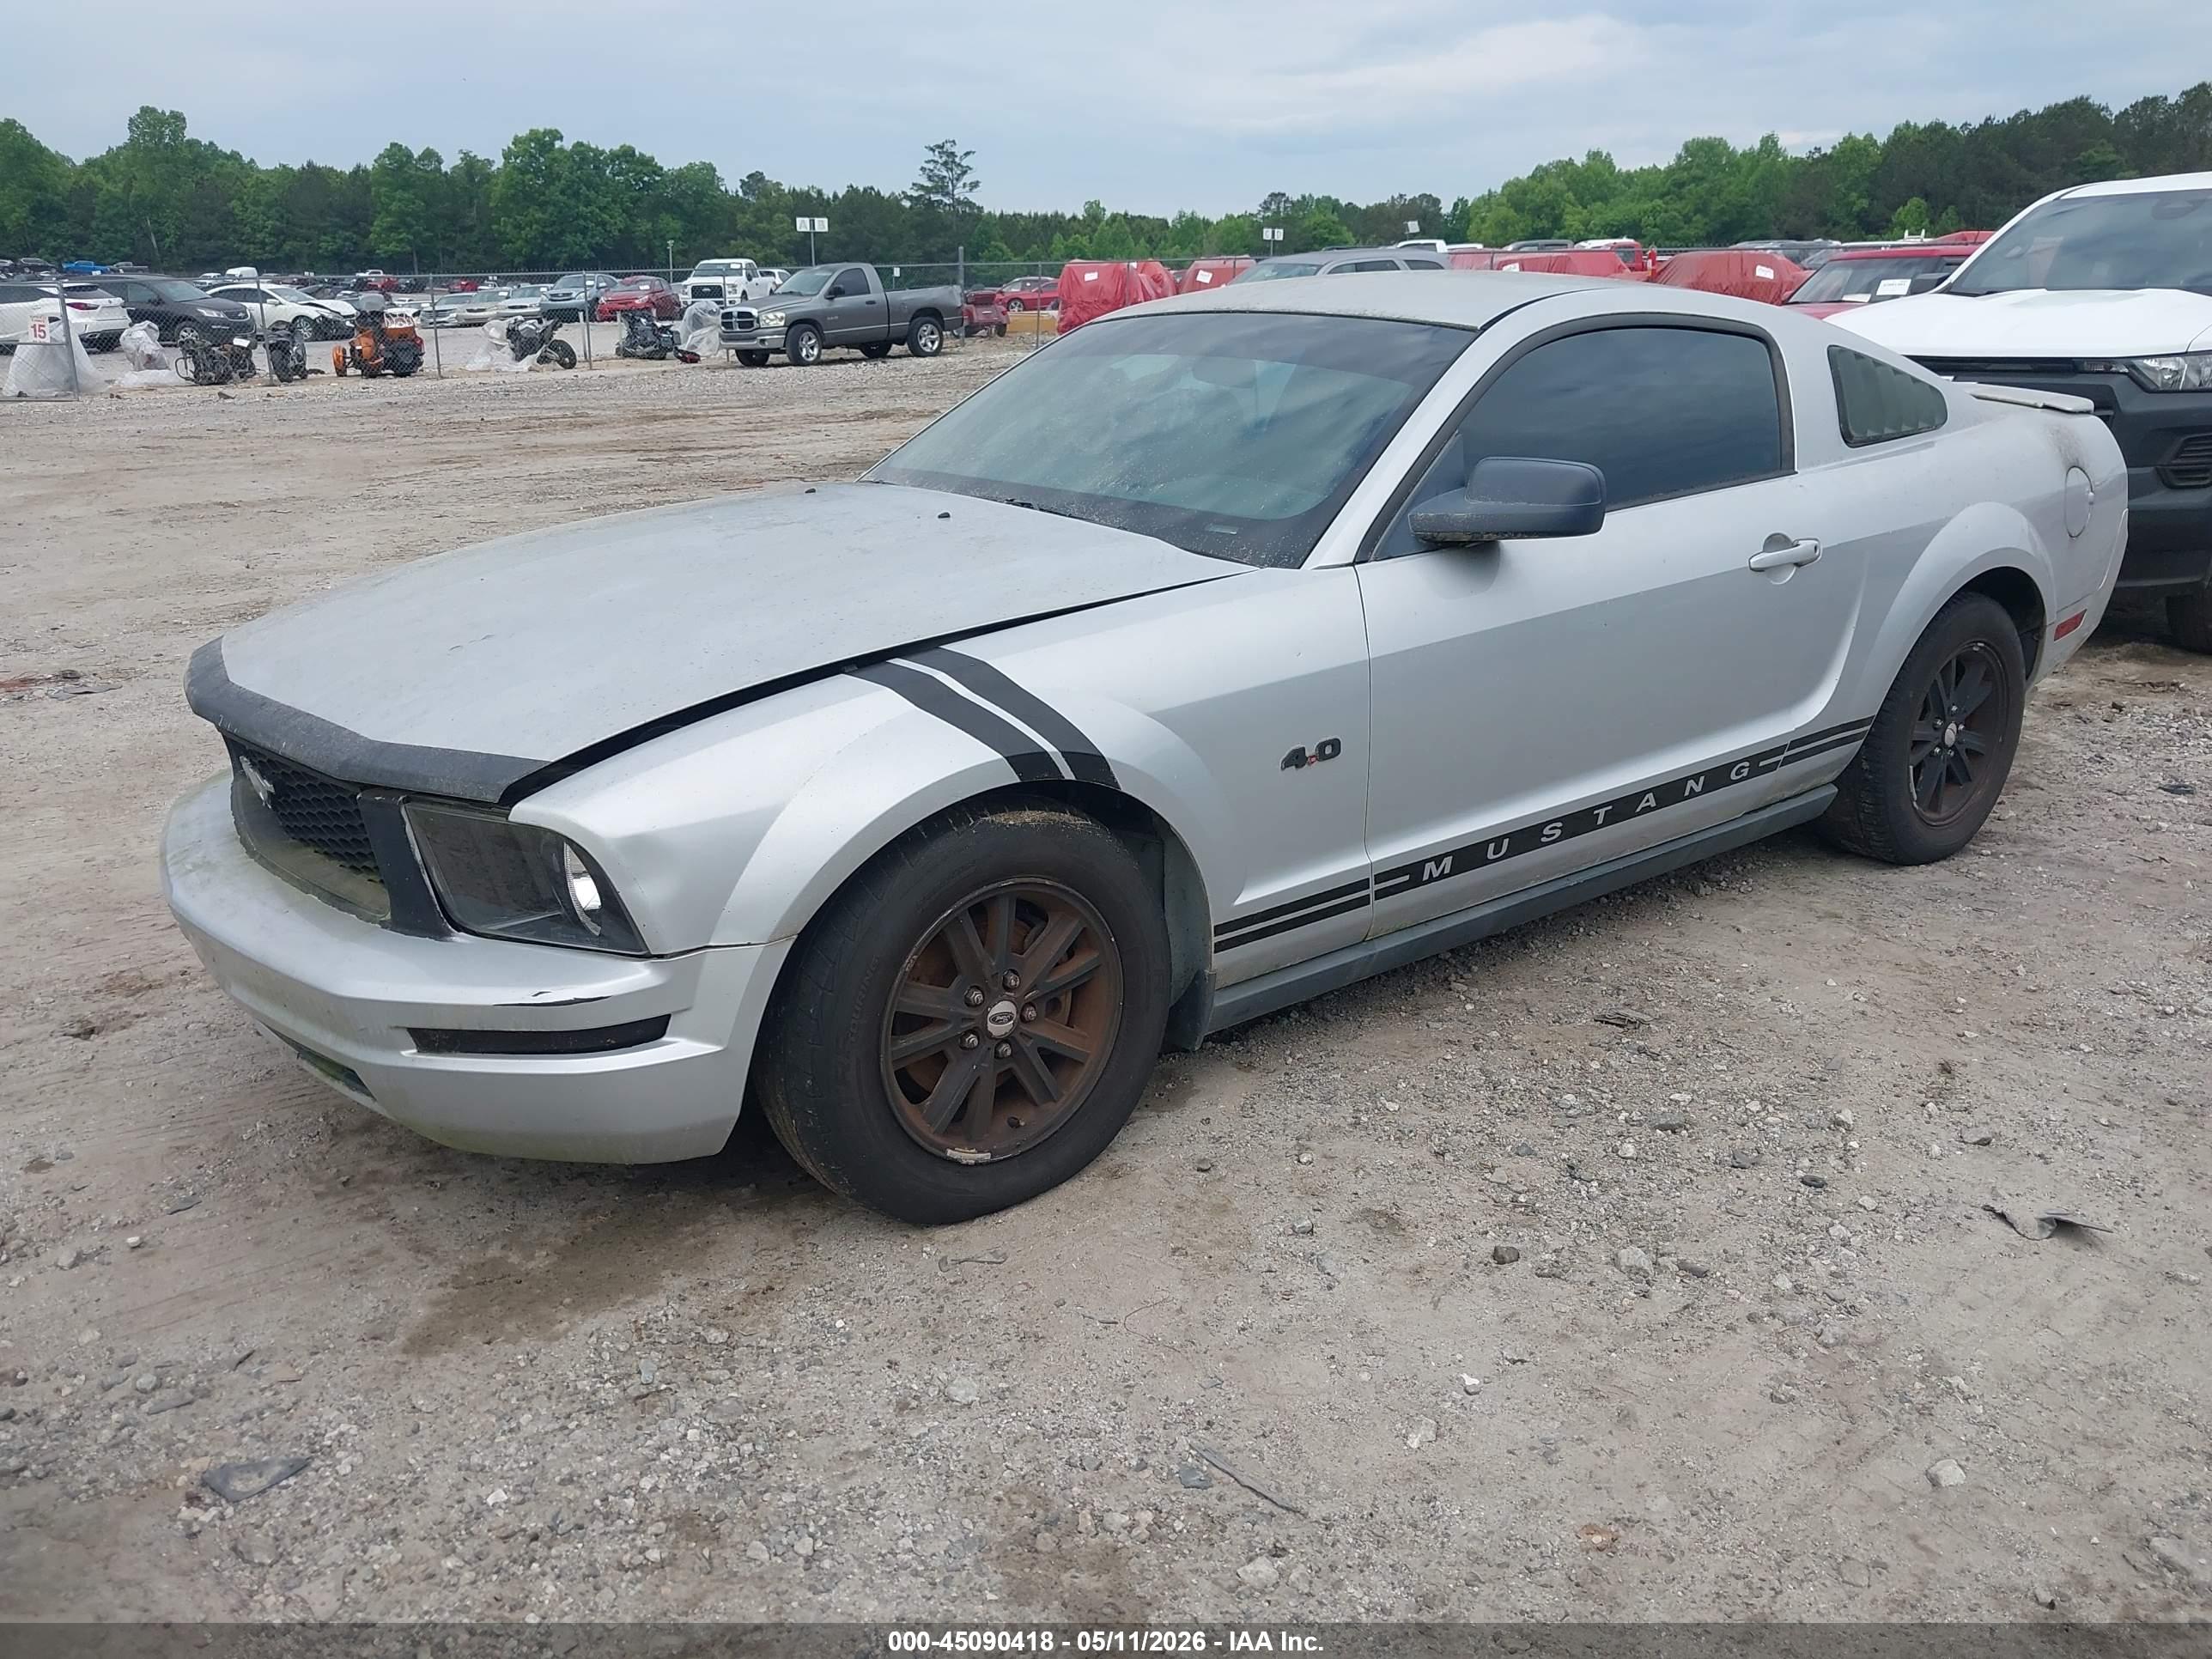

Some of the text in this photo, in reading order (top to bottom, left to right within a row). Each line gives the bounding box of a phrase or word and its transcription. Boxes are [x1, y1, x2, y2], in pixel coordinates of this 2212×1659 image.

[31, 323, 46, 339] 15
[1280, 737, 1341, 771] 4.0
[1421, 761, 1751, 882] MUSTANG
